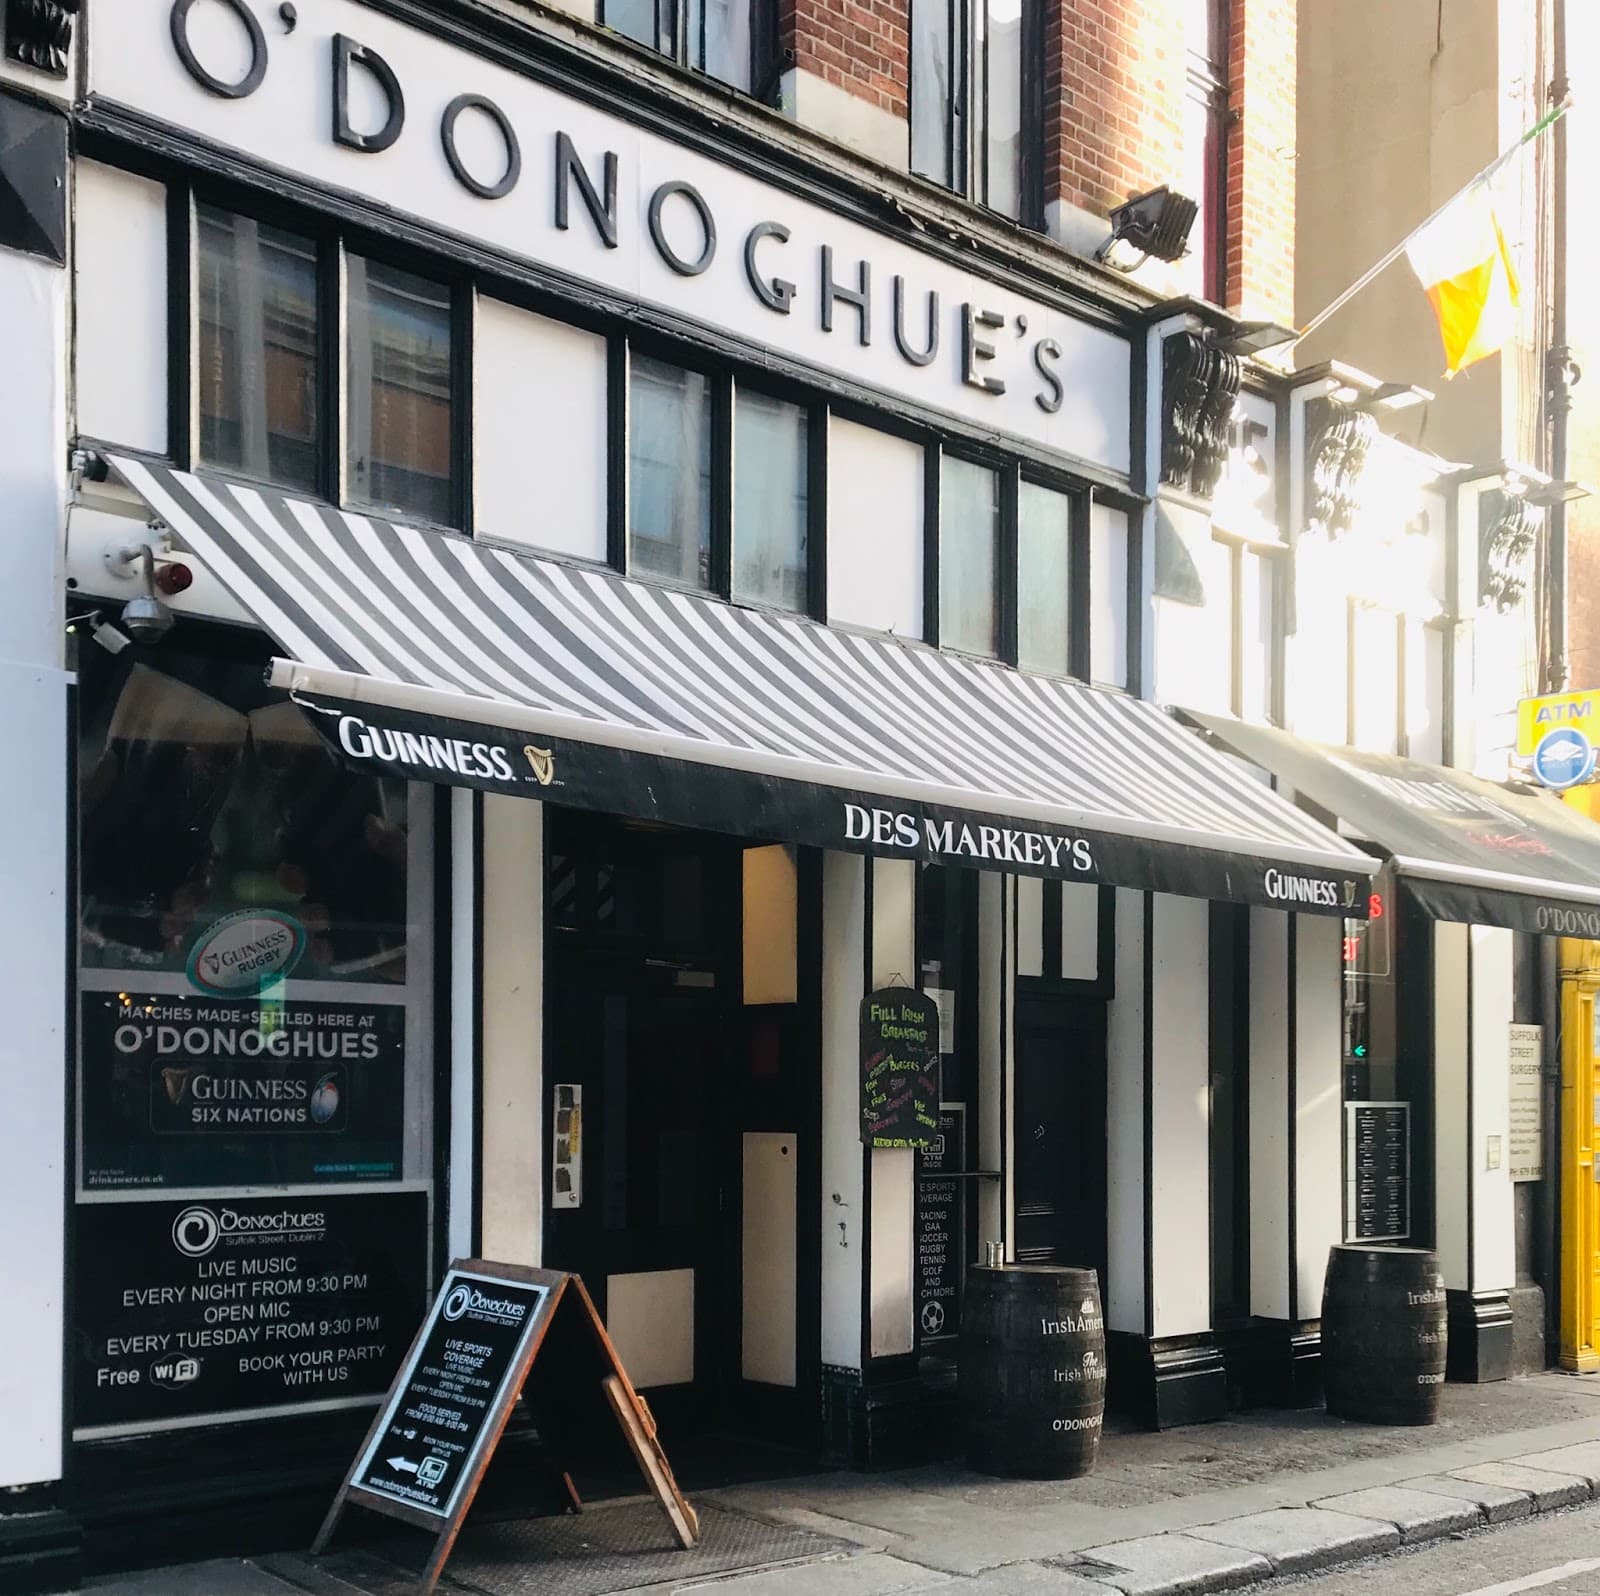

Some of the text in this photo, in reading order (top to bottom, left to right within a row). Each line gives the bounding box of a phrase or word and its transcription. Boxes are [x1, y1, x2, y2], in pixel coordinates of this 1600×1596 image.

[170, 0, 1064, 413] O'DONOGHUE'S
[1536, 701, 1591, 723] ATM
[338, 715, 514, 781] GUINNESS
[844, 803, 1093, 871] DES MARKEY'S
[1265, 868, 1337, 906] GUINNESS
[222, 930, 288, 966] GUINNESS
[237, 948, 281, 975] RUGBY
[119, 1005, 192, 1021] MATCHES
[197, 1008, 240, 1022] MADE
[318, 1014, 353, 1027] HERE
[358, 1015, 375, 1028] AT
[114, 1025, 379, 1059] O'DONOGHUES
[1509, 1048, 1534, 1058] STREET
[191, 1075, 307, 1101] GUINNESS
[191, 1107, 307, 1123] SIX NATIONS
[927, 1182, 957, 1192] SPORTS
[925, 1222, 941, 1232] GAA
[289, 1233, 315, 1244] Dublin
[317, 1232, 324, 1241] 2
[920, 1244, 946, 1254] RUGBY
[199, 1257, 297, 1278] LIVE MUSIC
[920, 1255, 946, 1265] TENNIS
[923, 1266, 943, 1276] GOLF
[123, 1274, 367, 1306] EVERY NIGHT FROM 9:30 PM
[925, 1277, 941, 1287] AND
[933, 1286, 955, 1297] MORE
[204, 1302, 290, 1323] OPEN MIC
[107, 1316, 380, 1355] EVERY TUESDAY FROM 9:30 PM
[444, 1338, 492, 1357] LIVE SPORTS
[239, 1345, 387, 1372] BOOK YOUR PARTY
[443, 1350, 484, 1368] COVERAGE
[1082, 1352, 1098, 1367] The
[97, 1368, 140, 1387] Free
[283, 1367, 348, 1386] WITH US
[1054, 1369, 1081, 1382] Irish
[404, 1408, 422, 1419] FROM
[457, 1422, 467, 1432] PM
[418, 1402, 461, 1421] FOOD SERVED
[416, 1478, 434, 1489] ATM
